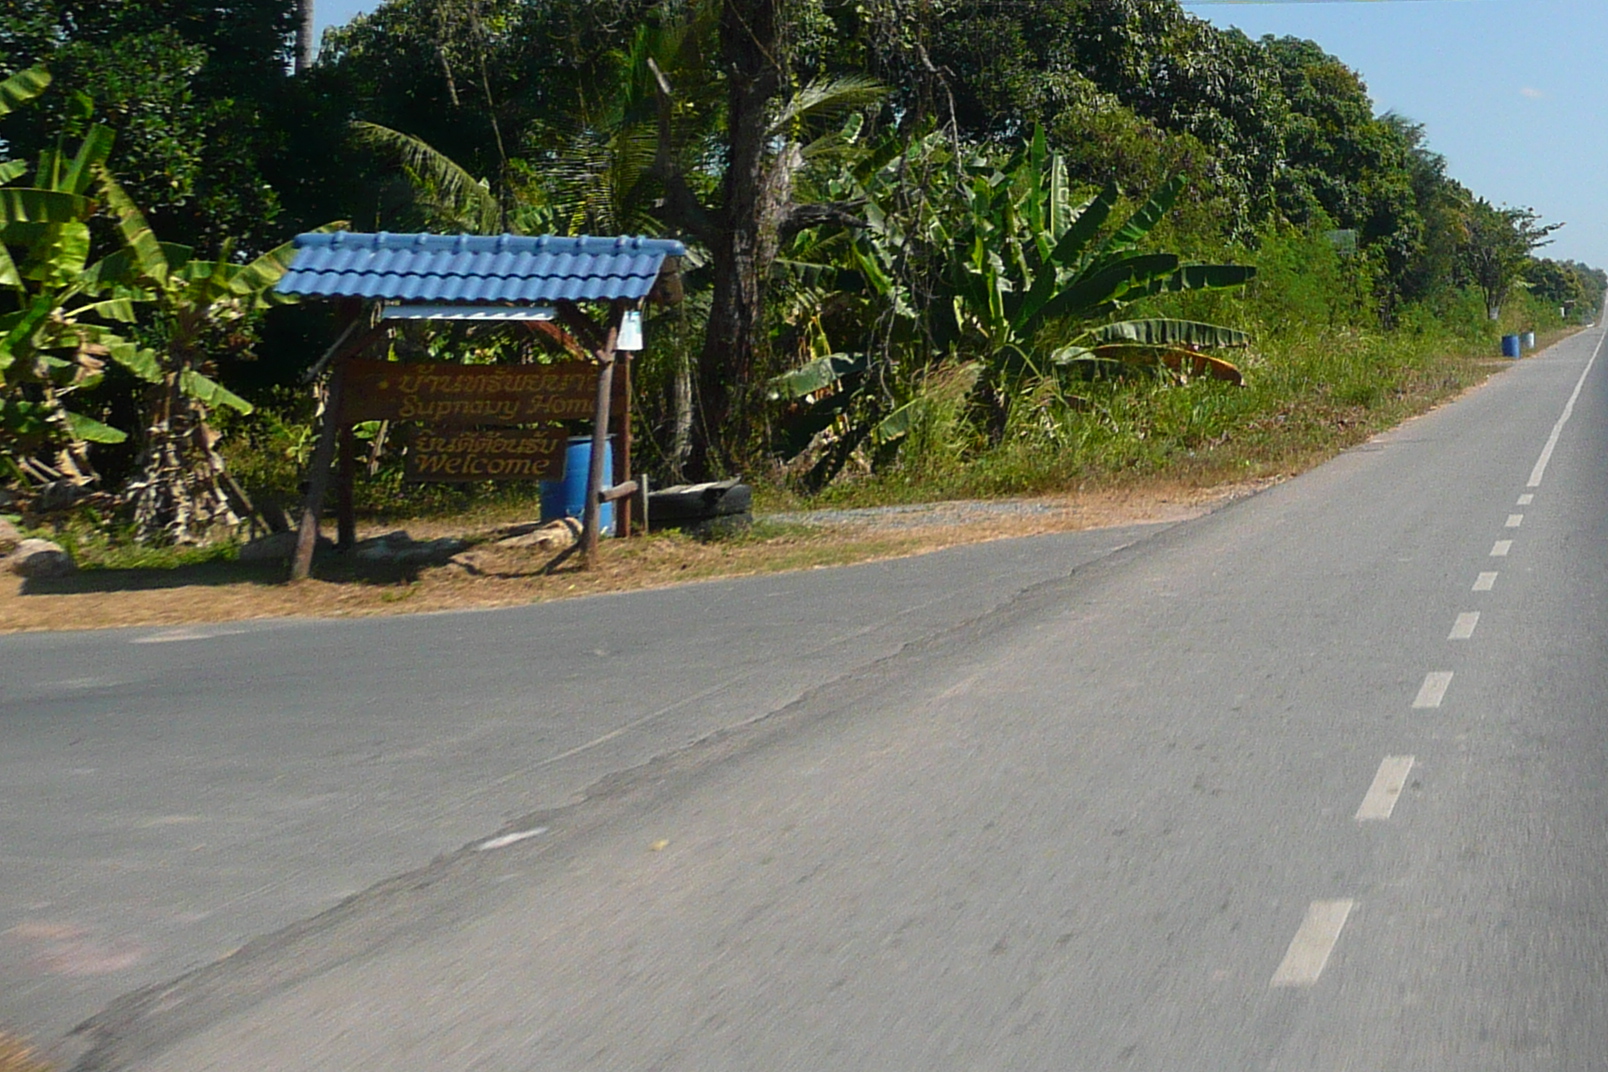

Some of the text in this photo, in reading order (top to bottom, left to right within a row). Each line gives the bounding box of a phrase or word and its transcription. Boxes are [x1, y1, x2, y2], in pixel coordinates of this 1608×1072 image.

[415, 429, 557, 454] ยินดีต้อนรับ
[415, 454, 550, 474] Welcome
